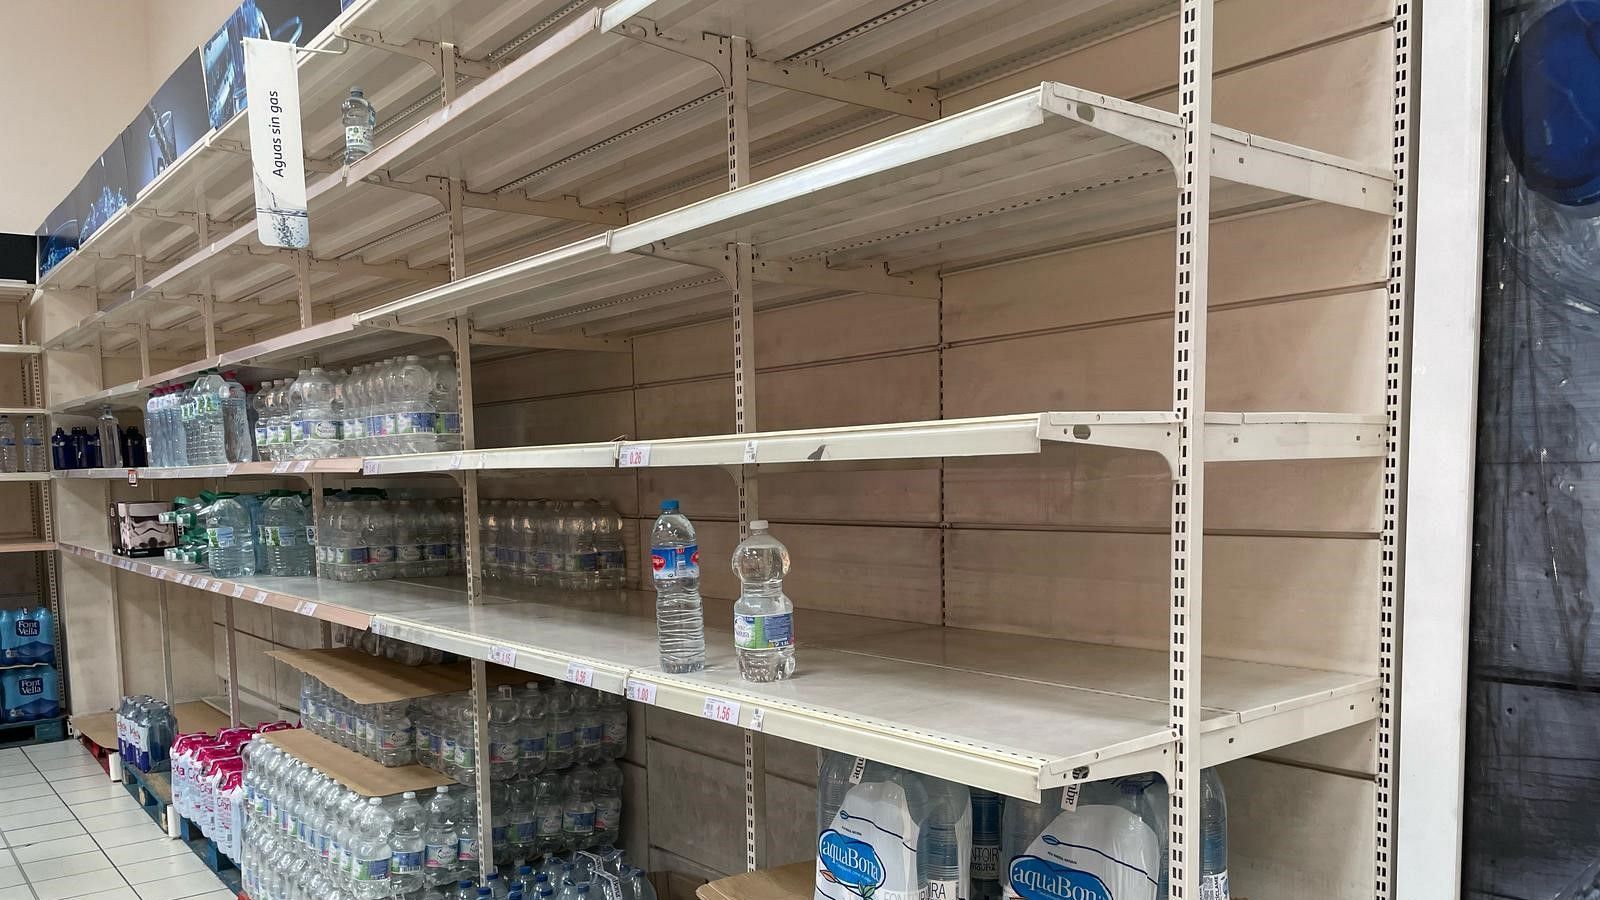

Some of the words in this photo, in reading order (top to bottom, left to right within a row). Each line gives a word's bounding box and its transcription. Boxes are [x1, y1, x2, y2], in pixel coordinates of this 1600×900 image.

[269, 90, 283, 113] gas
[268, 116, 281, 135] sin
[272, 137, 287, 178] Aguas
[18, 621, 38, 629] Font
[18, 627, 38, 636] Vella
[21, 680, 41, 688] Font
[21, 686, 41, 695] Vella
[716, 705, 731, 721] 1.56
[822, 842, 879, 882] aquaBona
[1013, 867, 1105, 900] aquaBon
